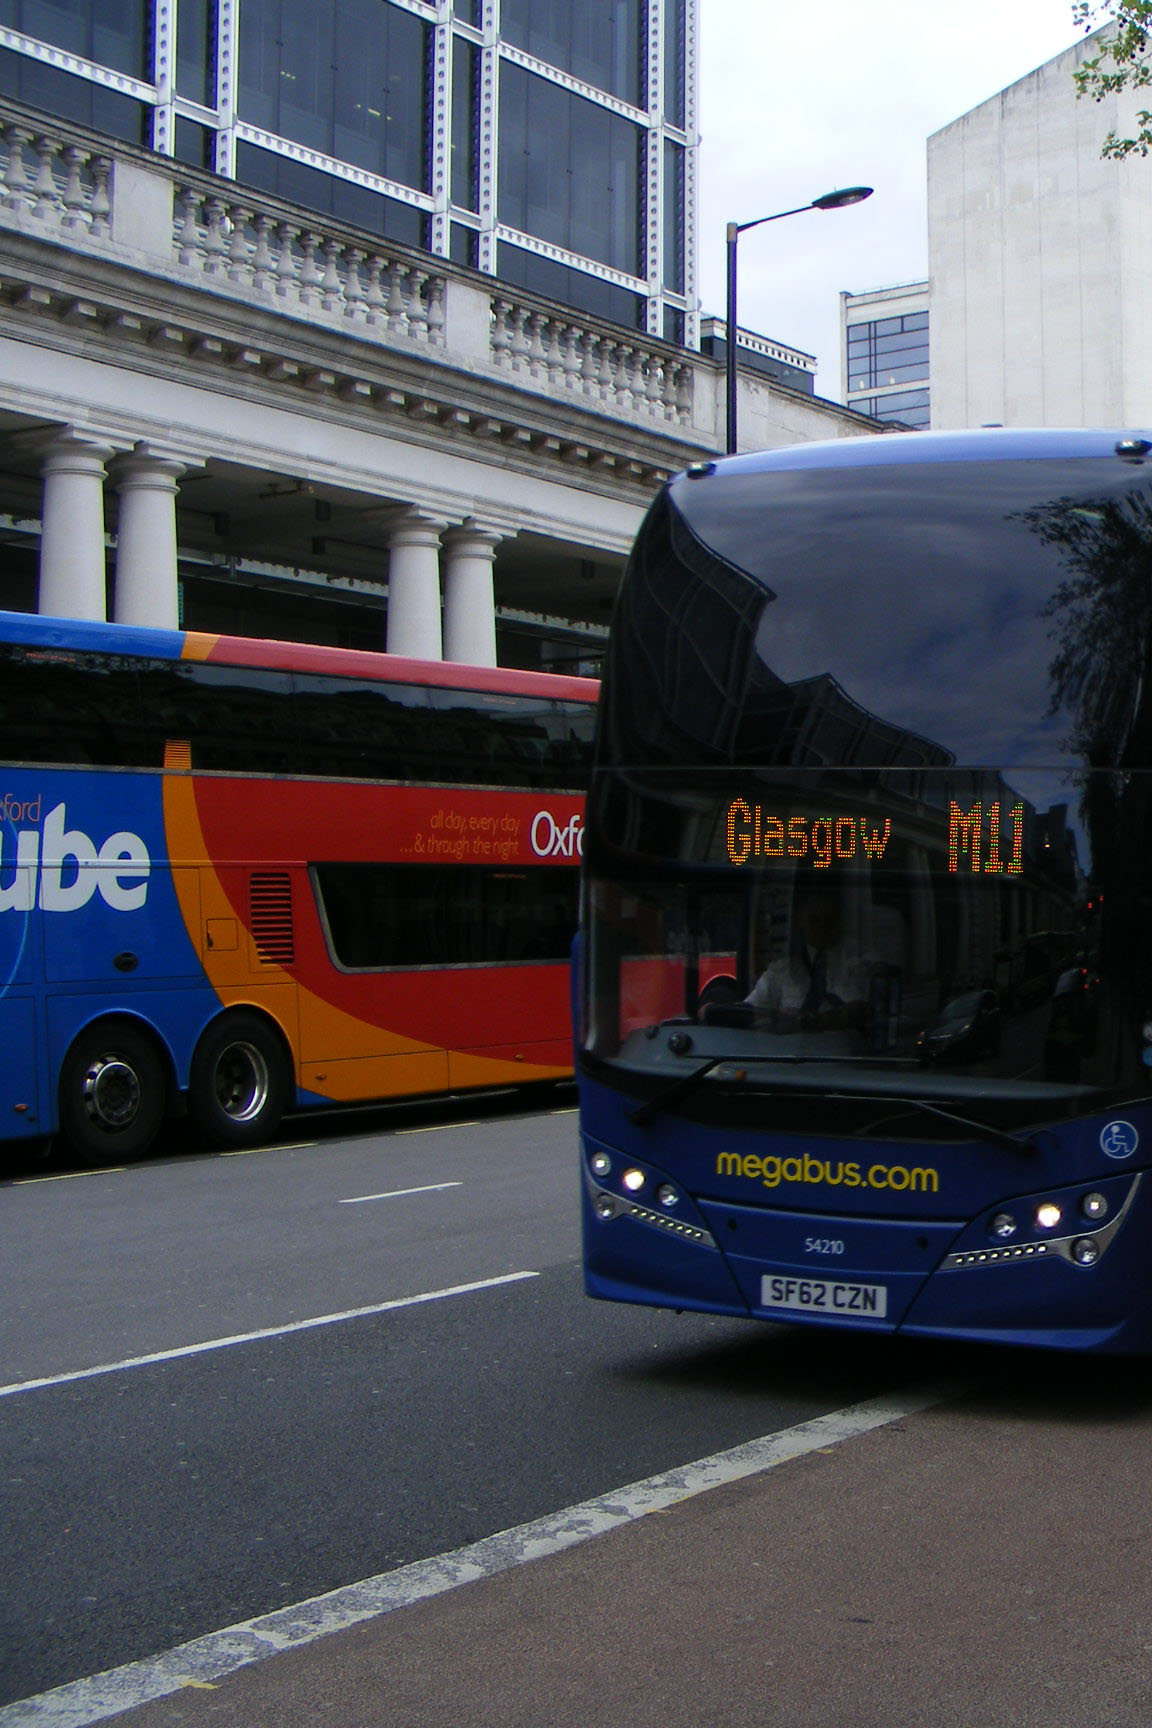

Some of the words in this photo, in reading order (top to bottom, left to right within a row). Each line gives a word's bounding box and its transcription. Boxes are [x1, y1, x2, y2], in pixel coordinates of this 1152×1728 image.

[431, 810, 444, 829] all
[469, 815, 499, 836] every
[501, 814, 521, 837] day
[727, 798, 891, 868] Glasgow
[949, 801, 1024, 873] M11
[0, 802, 151, 912] ube
[428, 834, 471, 860] through
[473, 837, 491, 854] the
[493, 838, 519, 860] night
[716, 1152, 939, 1193] megabus.com
[804, 1238, 845, 1255] 54210
[770, 1279, 826, 1307] SF62
[832, 1285, 877, 1311] CZN
